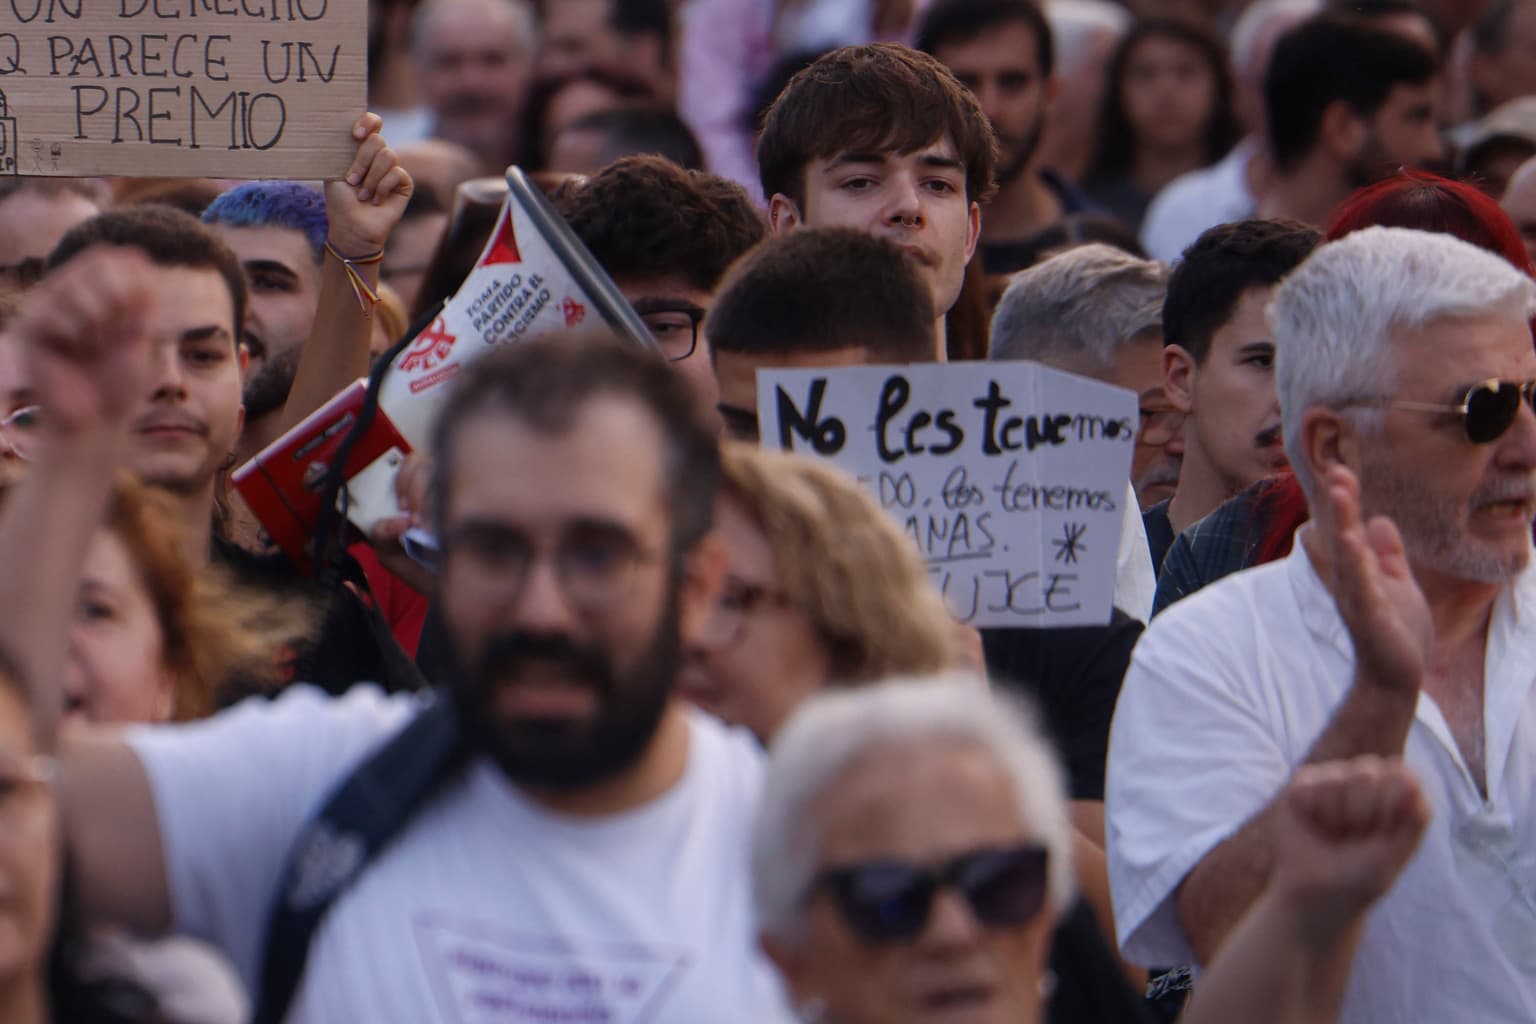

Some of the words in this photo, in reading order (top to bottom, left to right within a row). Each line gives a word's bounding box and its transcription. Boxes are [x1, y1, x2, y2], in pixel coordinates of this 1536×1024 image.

[47, 33, 232, 81] PARECE
[260, 39, 341, 83] UN
[70, 84, 286, 152] PREMIO
[466, 279, 501, 317] TOMA
[473, 273, 522, 331] PARTIDO
[483, 287, 532, 345] CONTRA
[775, 377, 846, 456] No
[874, 374, 965, 464] les
[972, 378, 1134, 456] tenemos
[992, 461, 1117, 513] tenemos
[905, 512, 1010, 559] ANAS.
